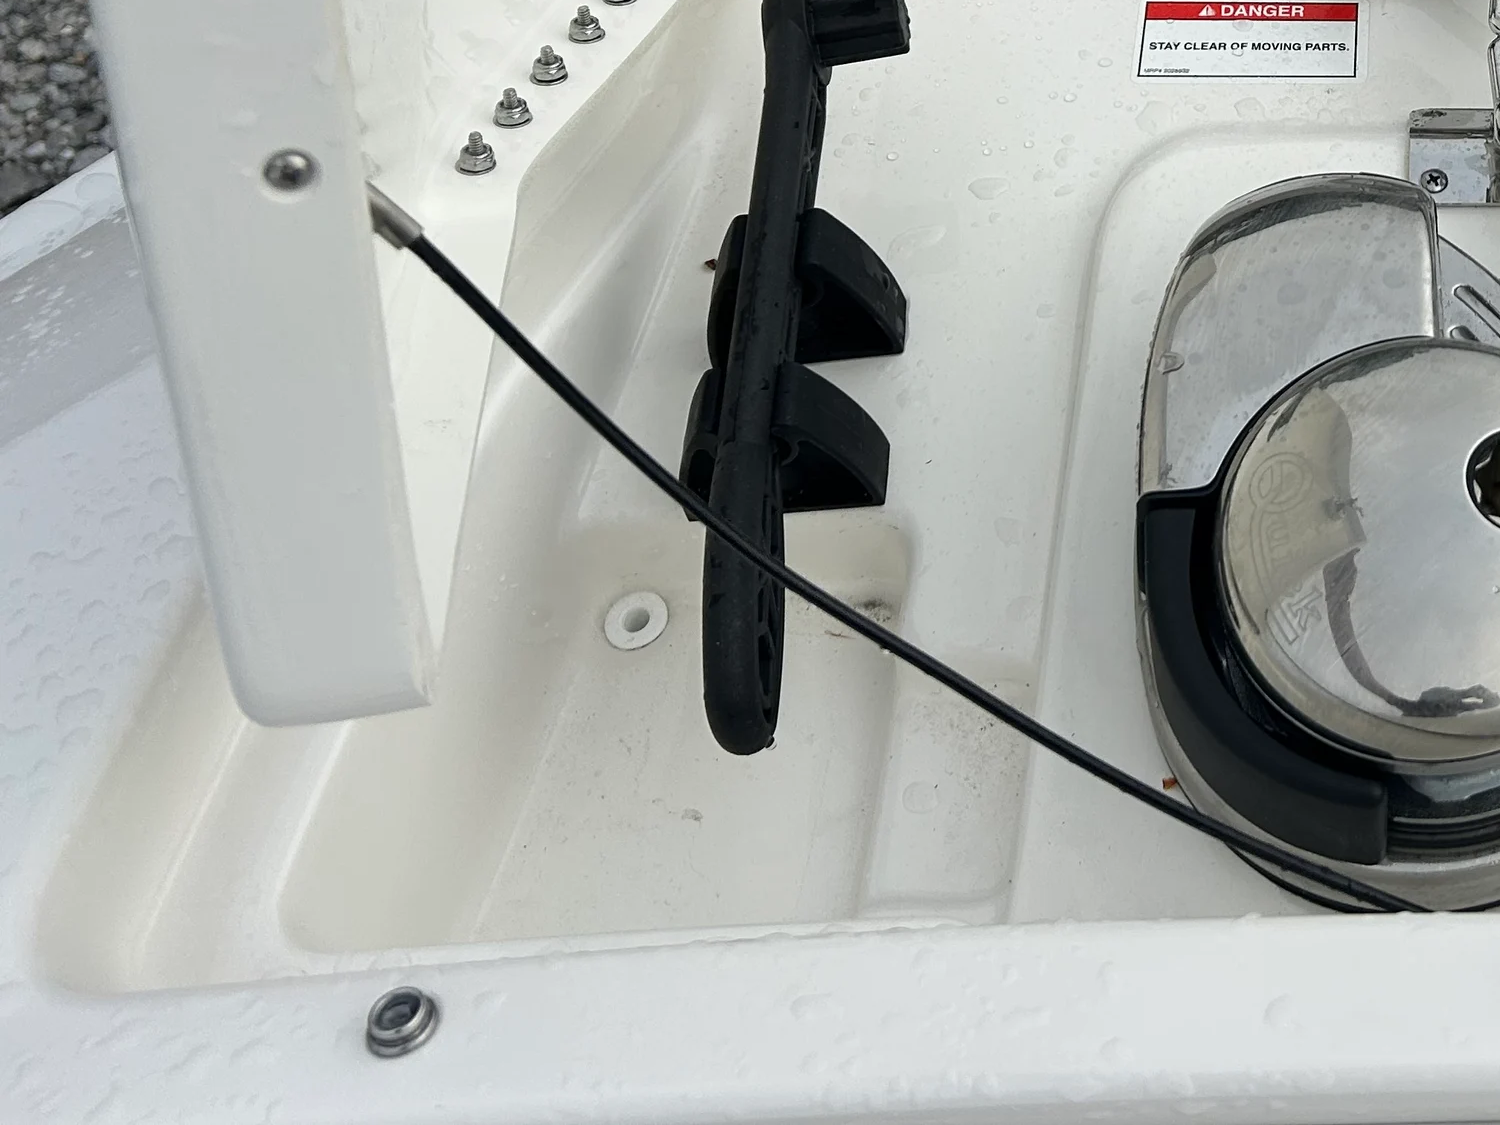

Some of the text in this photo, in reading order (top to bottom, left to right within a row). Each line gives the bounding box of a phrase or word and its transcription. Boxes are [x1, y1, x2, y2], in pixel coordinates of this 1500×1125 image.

[1221, 5, 1305, 18] DANGER
[1149, 41, 1350, 52] STAY CLEAR OF MOVING PARTS.
